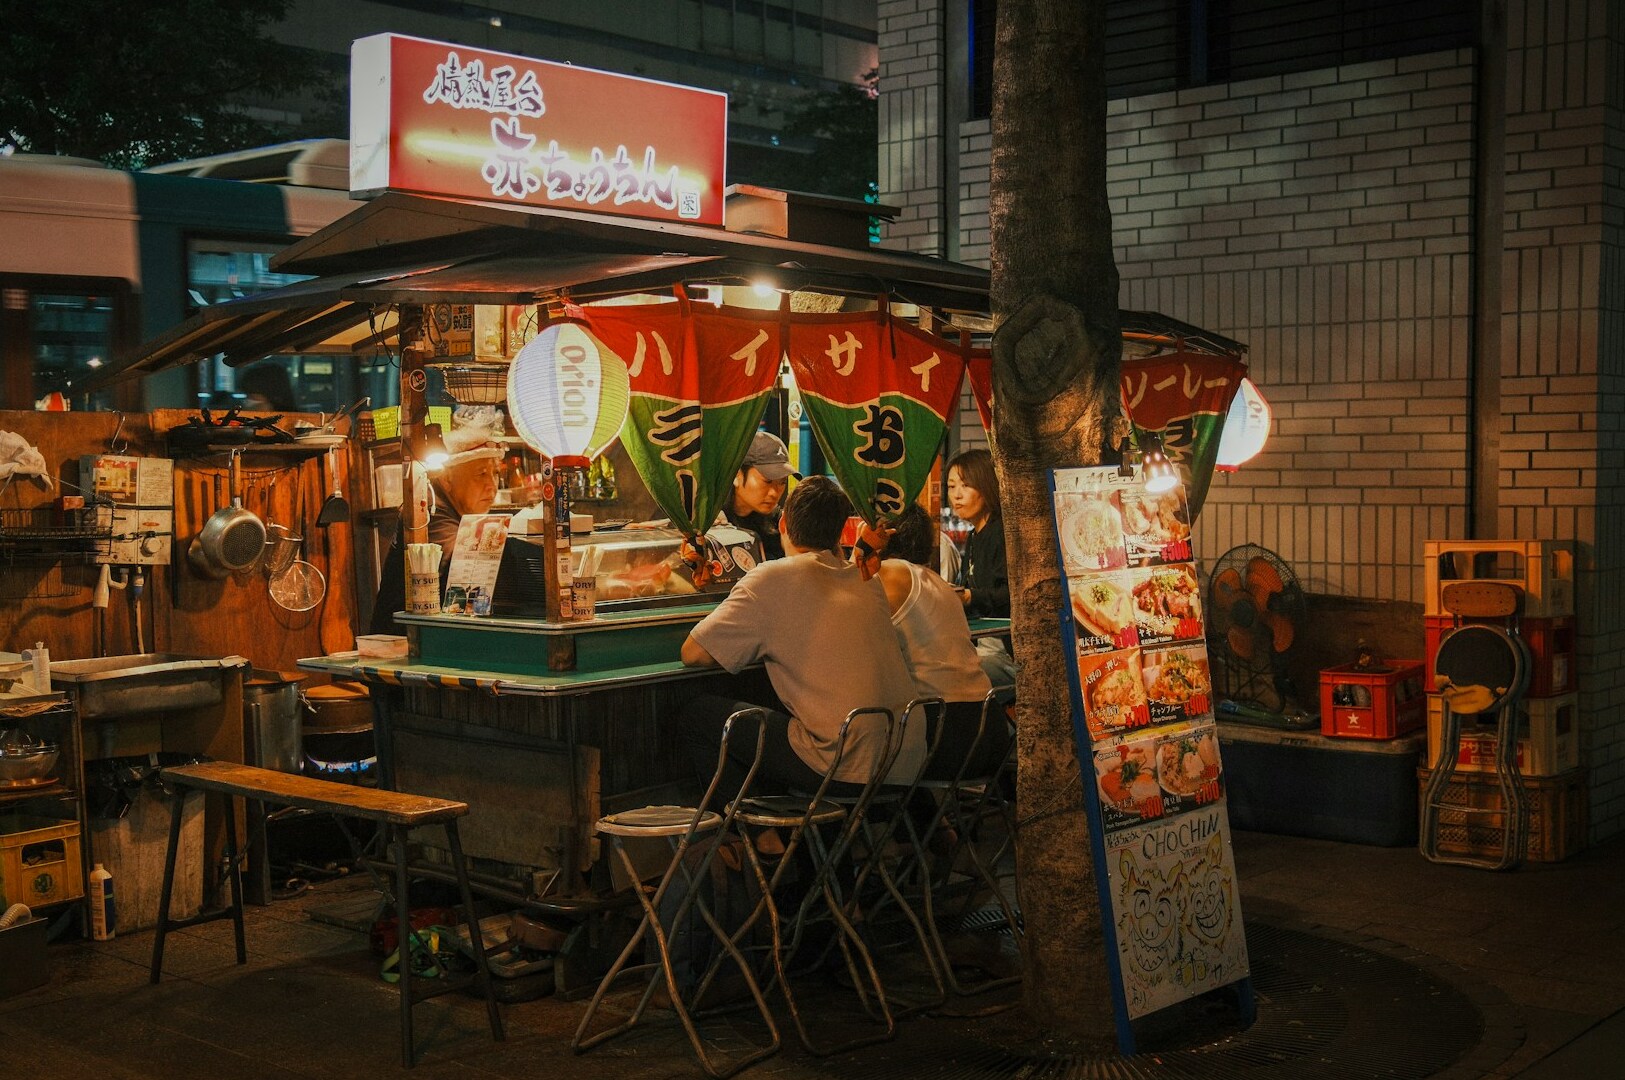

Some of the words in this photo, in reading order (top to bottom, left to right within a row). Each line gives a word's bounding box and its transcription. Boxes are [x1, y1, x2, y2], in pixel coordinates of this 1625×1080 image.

[426, 53, 544, 116] 情熱屋台
[482, 118, 677, 209] 赤ちょうちん
[1142, 813, 1219, 860] CHOCHIN
